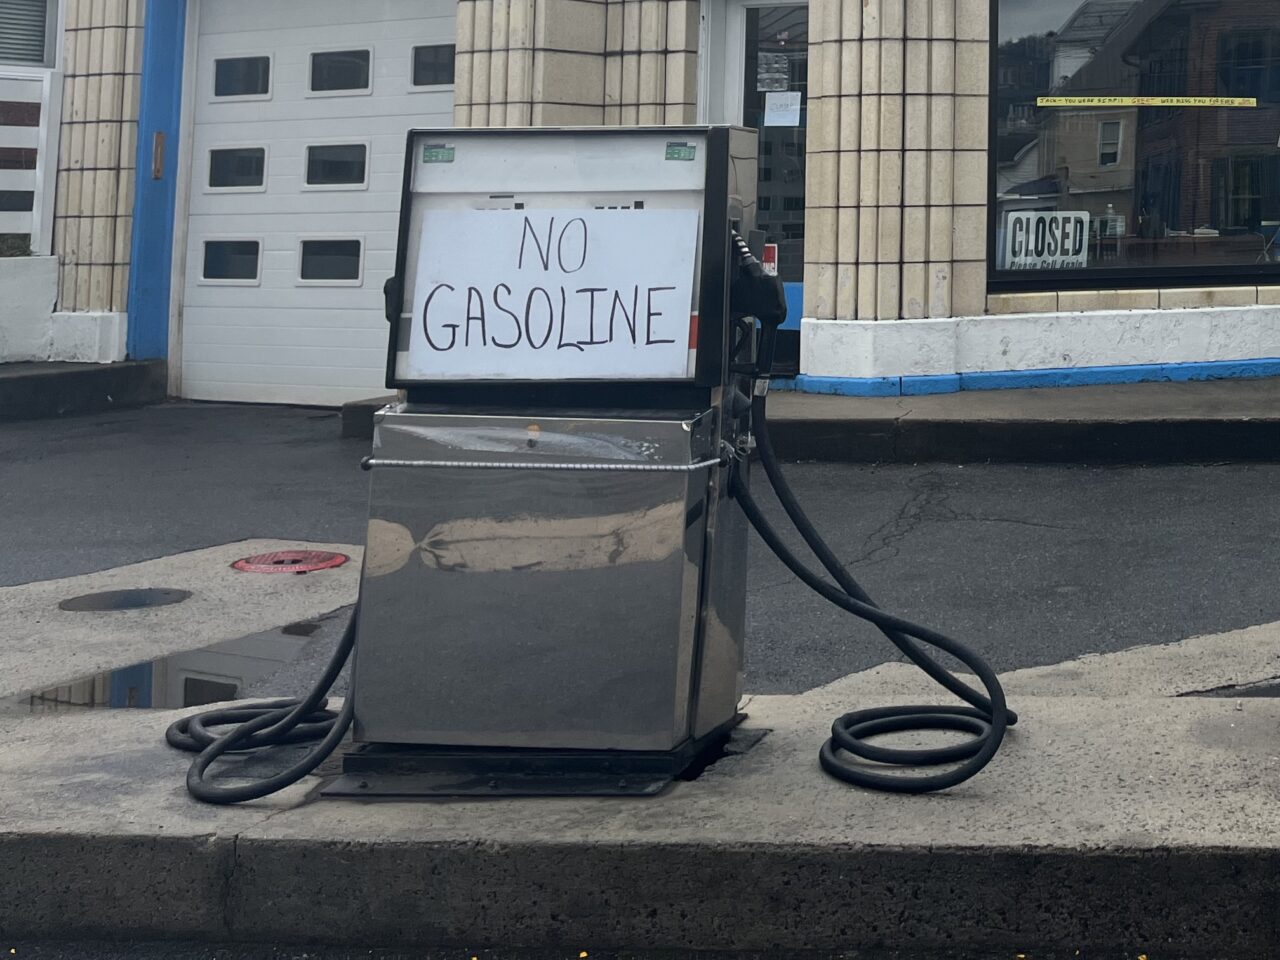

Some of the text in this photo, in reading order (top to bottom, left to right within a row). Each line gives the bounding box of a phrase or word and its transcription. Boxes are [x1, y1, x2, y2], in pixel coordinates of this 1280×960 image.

[518, 216, 587, 273] NO
[1011, 216, 1084, 258] CLOSED
[1010, 259, 1083, 270] Please Call Again
[423, 283, 676, 351] GASOLINE
